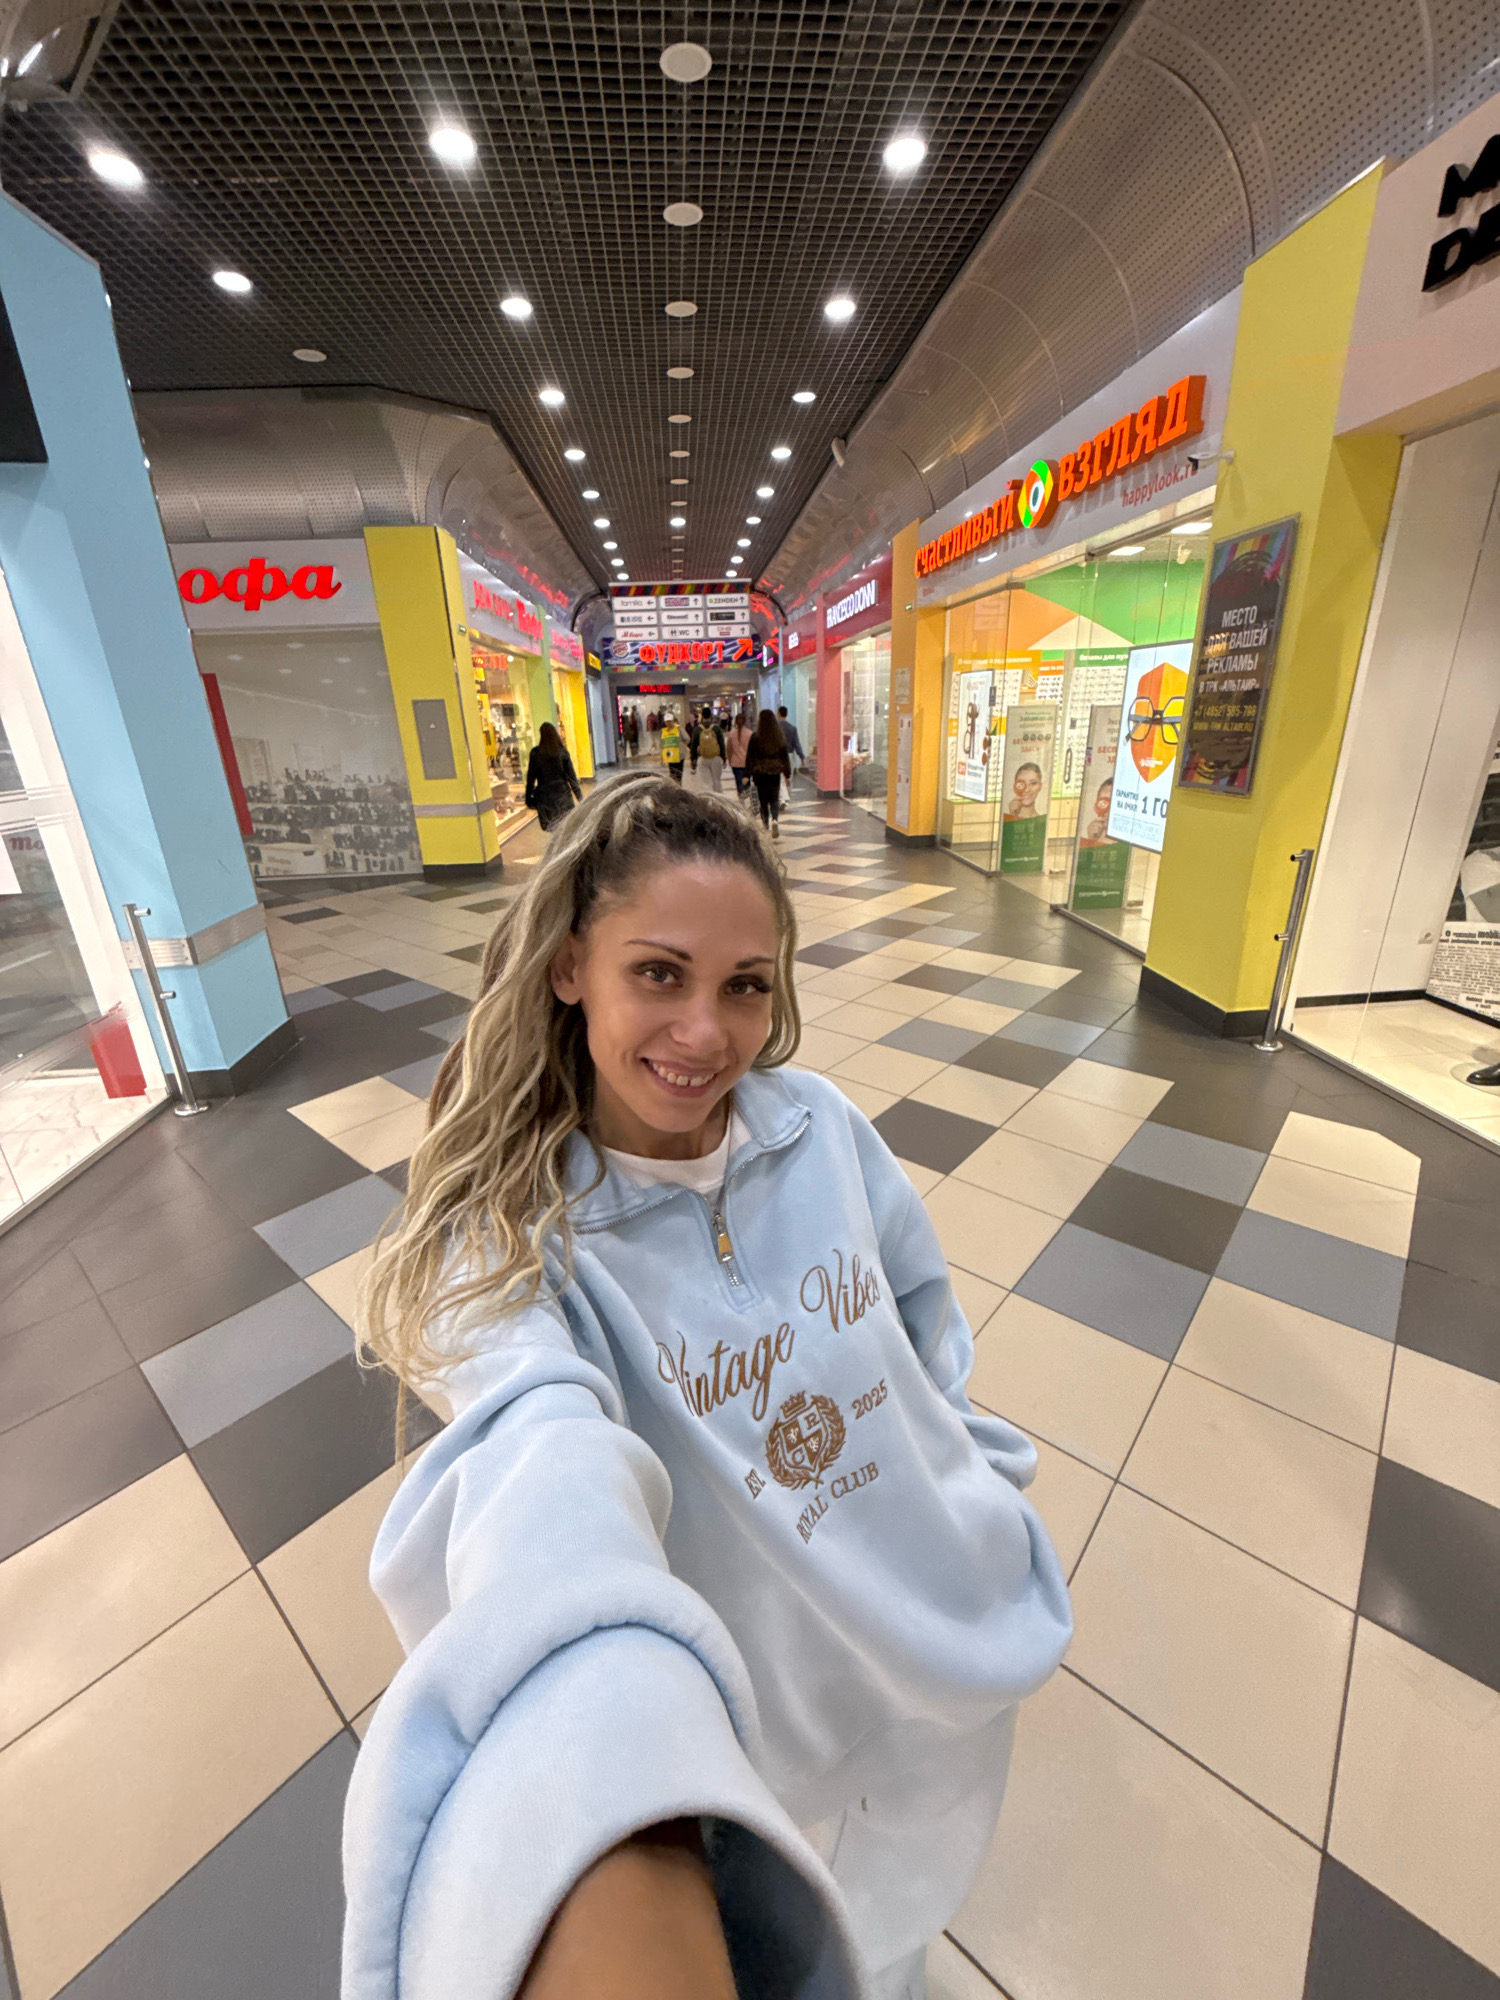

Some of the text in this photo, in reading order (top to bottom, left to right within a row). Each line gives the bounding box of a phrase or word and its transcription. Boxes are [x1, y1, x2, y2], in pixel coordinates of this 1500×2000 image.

[1058, 375, 1206, 501] ВЗГЛЯД
[1222, 605, 1258, 628] МЕСТО
[1229, 624, 1268, 650] ВАШЕЙ
[638, 640, 726, 664] ФУДКОРТ
[1206, 653, 1259, 674] РЕКЛАМЫ
[1206, 680, 1219, 693] ТРК
[1141, 796, 1149, 815] 1
[800, 1248, 881, 1334] Vibes
[656, 1322, 795, 1422] Vintage
[851, 1378, 889, 1420] 2025
[804, 1411, 821, 1431] R
[830, 1461, 880, 1500] CLUB
